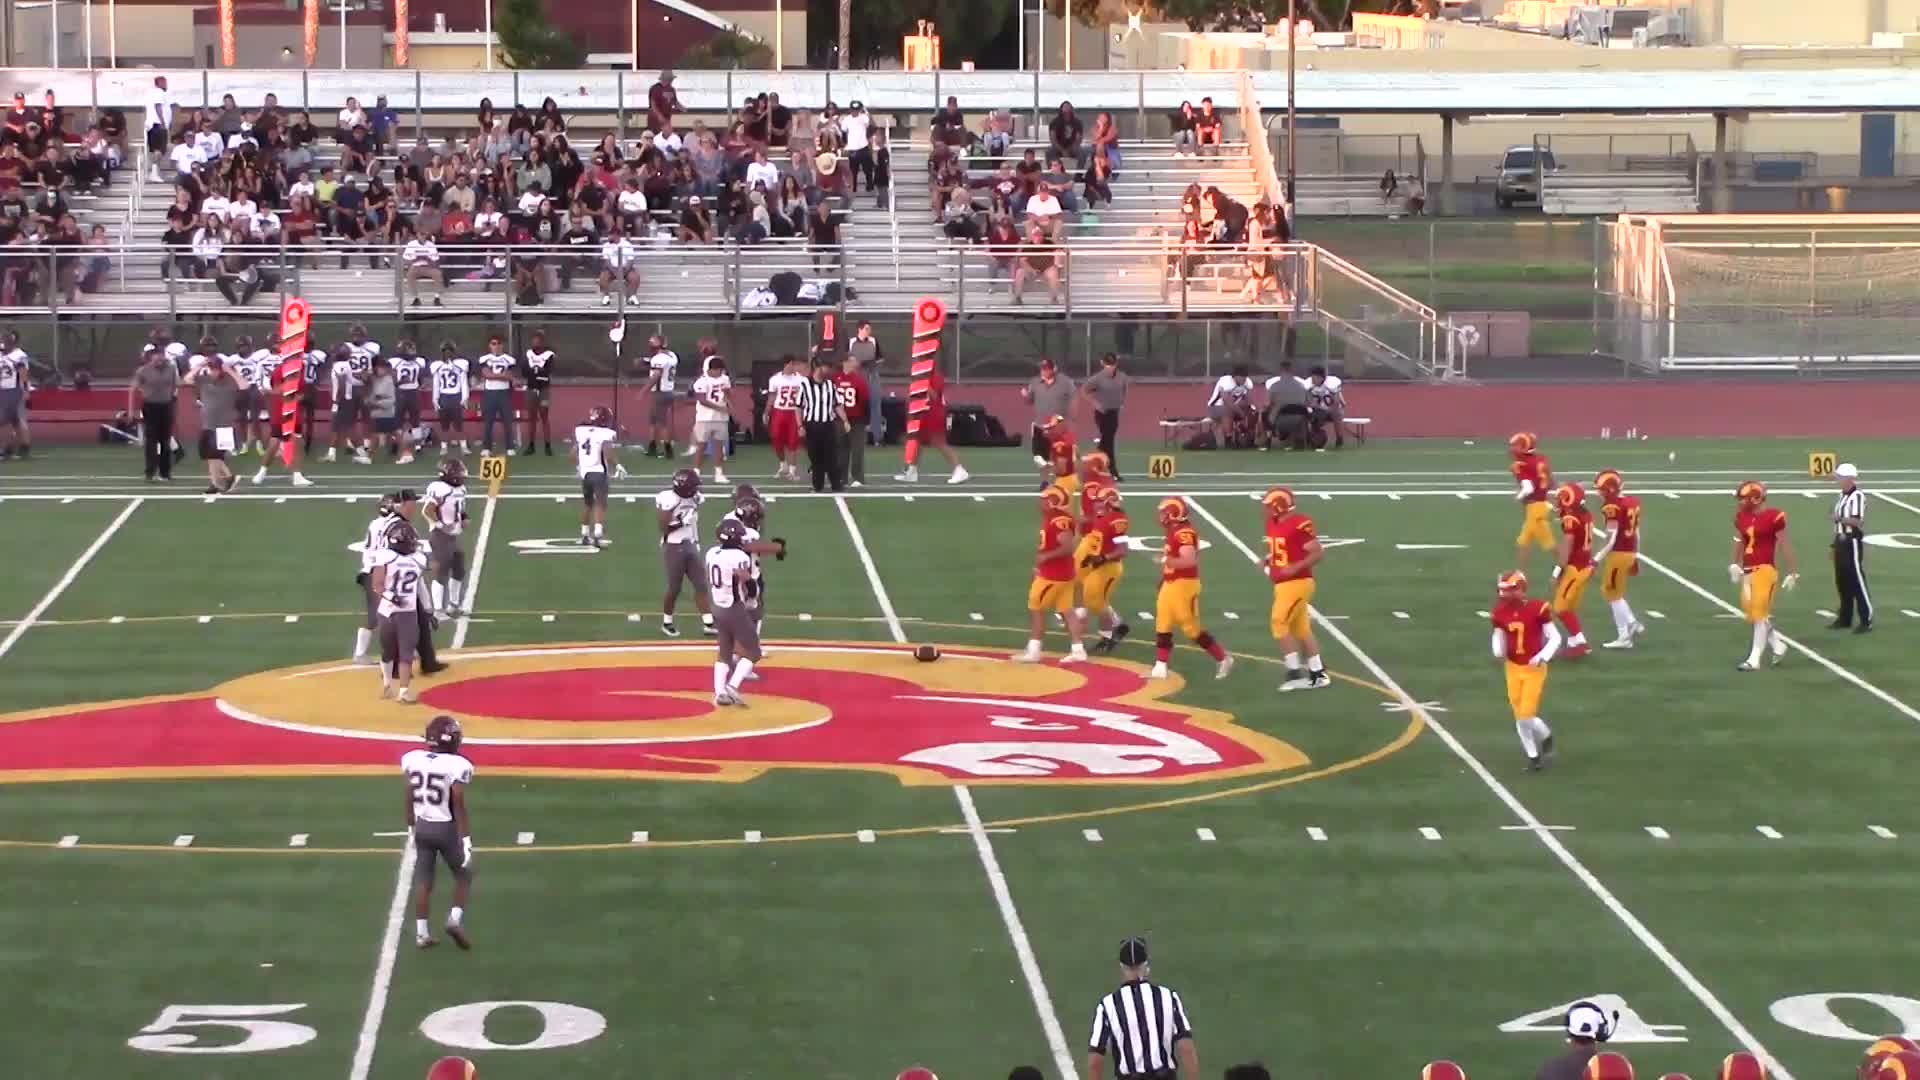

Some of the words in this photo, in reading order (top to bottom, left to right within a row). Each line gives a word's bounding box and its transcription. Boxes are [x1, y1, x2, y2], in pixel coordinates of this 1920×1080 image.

[823, 315, 834, 339] 1
[400, 367, 416, 383] 21
[440, 371, 458, 389] 13
[779, 386, 800, 407] 55
[582, 438, 591, 456] 4
[482, 460, 502, 479] 50
[1151, 458, 1172, 478] 40
[1813, 456, 1833, 475] 30
[1746, 526, 1756, 555] 1
[393, 569, 418, 594] 12
[1507, 620, 1526, 655] 7
[408, 770, 446, 806] 25
